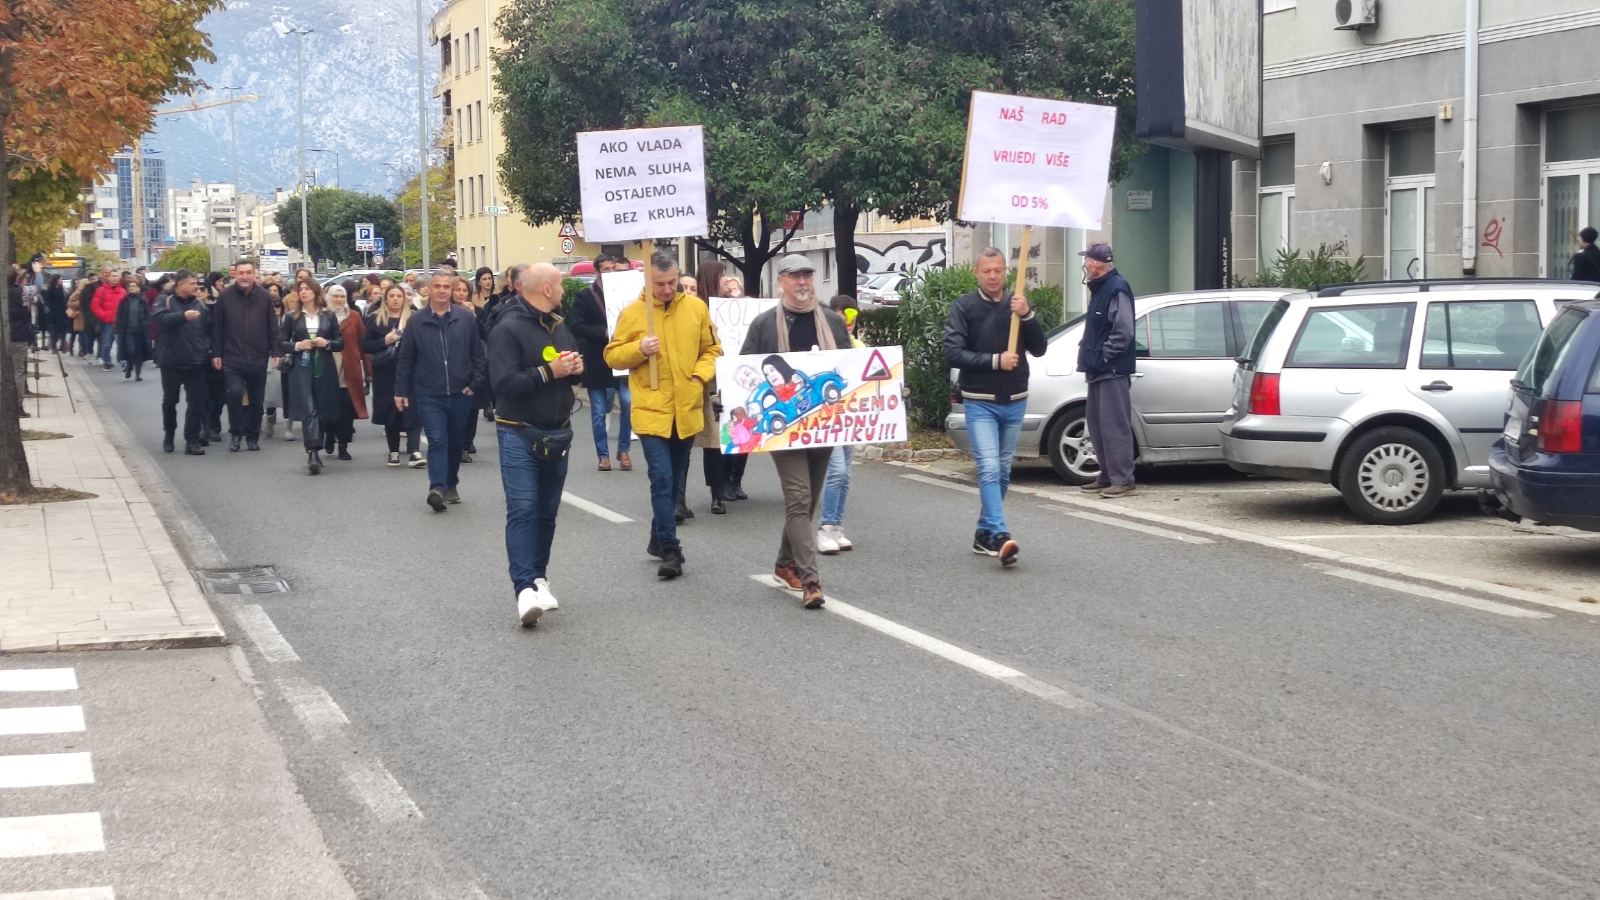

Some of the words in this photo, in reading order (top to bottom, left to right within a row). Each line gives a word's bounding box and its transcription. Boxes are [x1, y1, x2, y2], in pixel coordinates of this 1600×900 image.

[999, 106, 1024, 121] NAŠ
[1041, 112, 1067, 125] RAD
[600, 141, 628, 153] AKO
[637, 138, 682, 152] VLADA
[993, 150, 1036, 165] VRIJEDI
[1046, 151, 1070, 167] VIŠE
[595, 166, 637, 179] NEMA
[648, 162, 692, 175] SLUHA
[604, 184, 677, 202] OSTAJEMO
[1011, 195, 1028, 207] OD
[1032, 196, 1048, 209] 5%
[614, 211, 638, 224] BEZ
[648, 205, 695, 220] KRUHA
[361, 229, 368, 238] P
[563, 241, 573, 251] 50
[797, 414, 879, 433] NAZADNU
[788, 423, 897, 447] POLITIKU!!!
